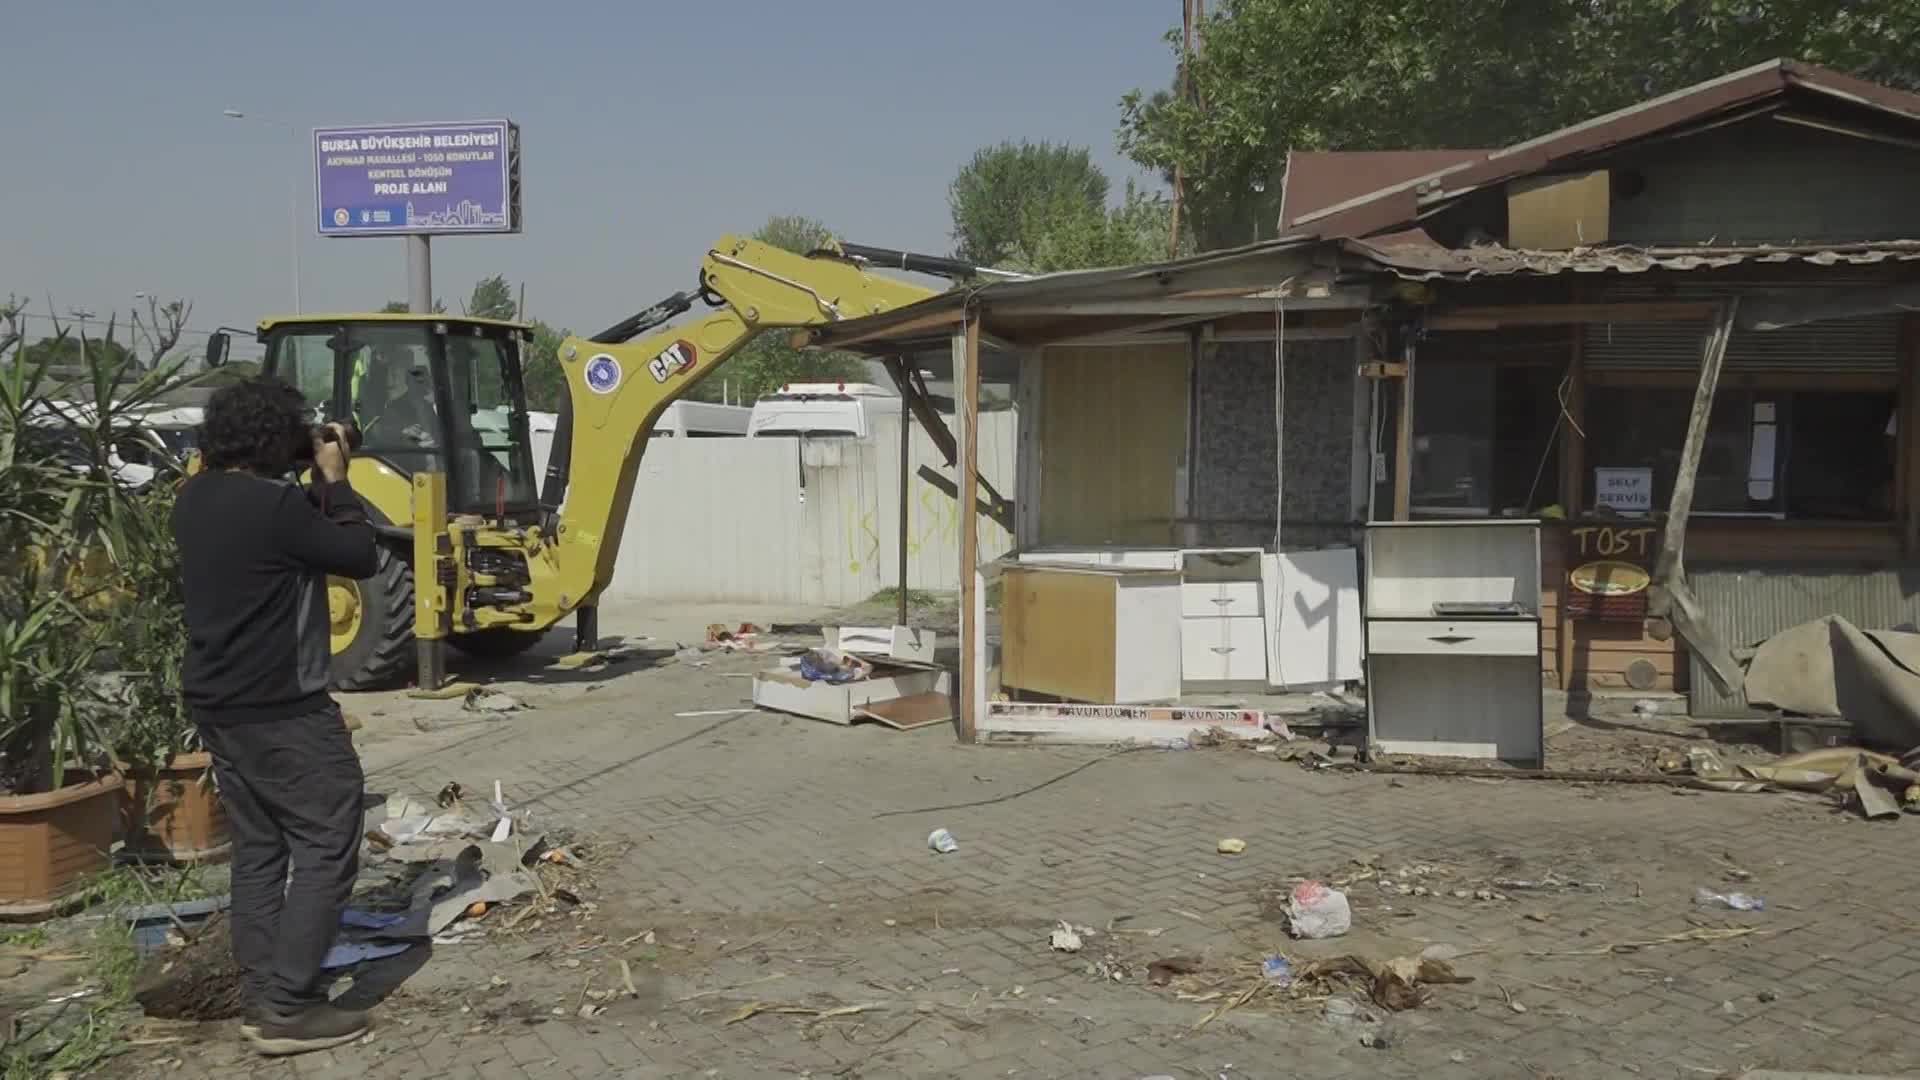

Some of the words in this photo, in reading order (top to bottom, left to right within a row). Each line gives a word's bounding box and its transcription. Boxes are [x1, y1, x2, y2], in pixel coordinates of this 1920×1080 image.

[321, 138, 358, 152] BURSA
[361, 134, 431, 151] BÜYÜKŞEHİR
[433, 131, 498, 147] BELEDİYESİ
[374, 183, 409, 195] PROJE
[412, 181, 447, 194] ALANI
[648, 343, 687, 382] CAT
[1607, 477, 1640, 488] SELF
[1572, 527, 1656, 555] TOST
